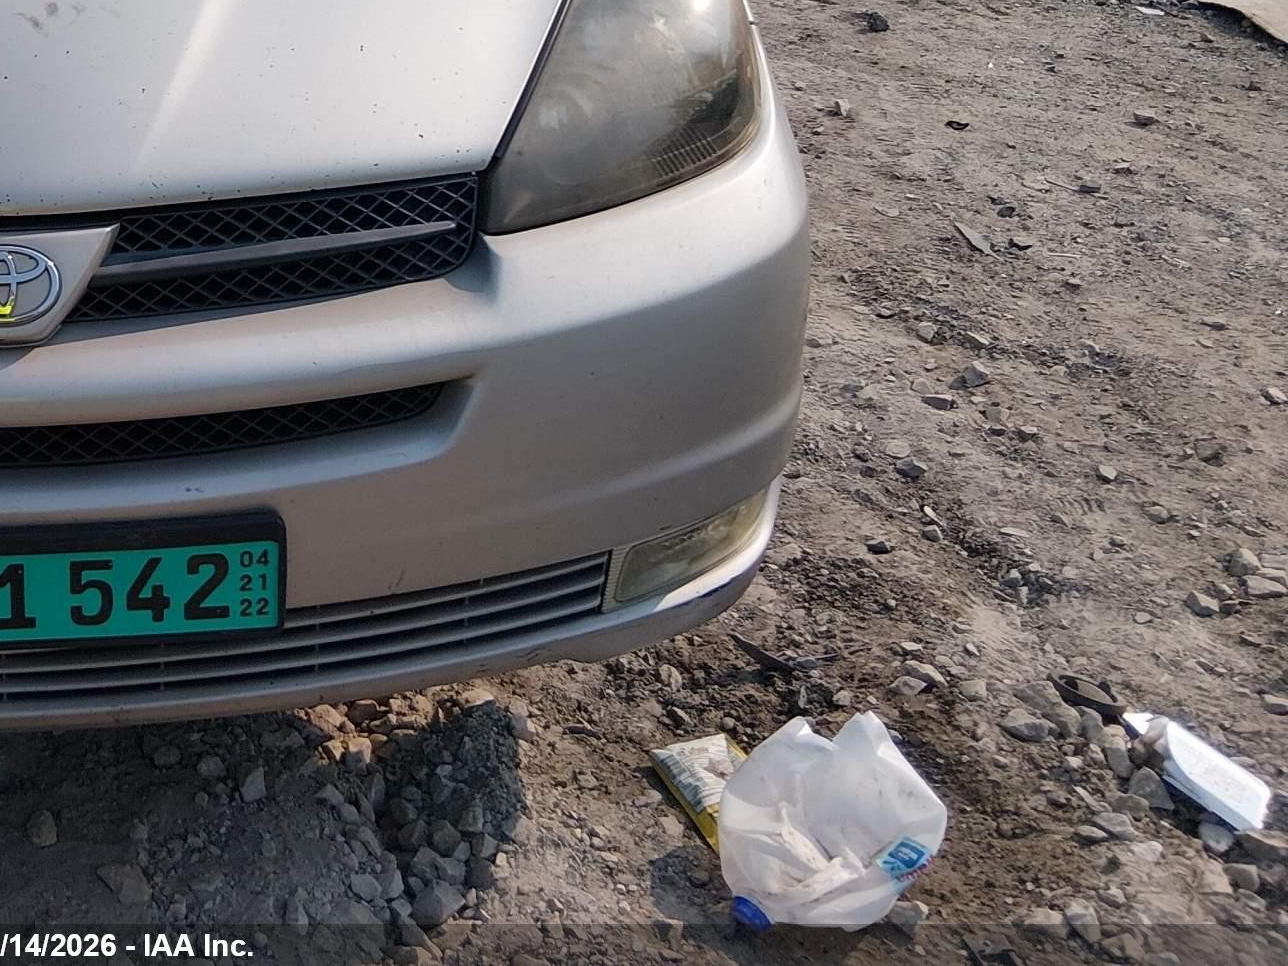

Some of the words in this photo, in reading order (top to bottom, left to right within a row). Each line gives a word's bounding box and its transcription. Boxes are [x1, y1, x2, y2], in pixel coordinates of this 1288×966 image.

[239, 548, 270, 568] 04
[69, 552, 230, 627] 542
[239, 573, 267, 592] 21
[239, 597, 269, 617] 22
